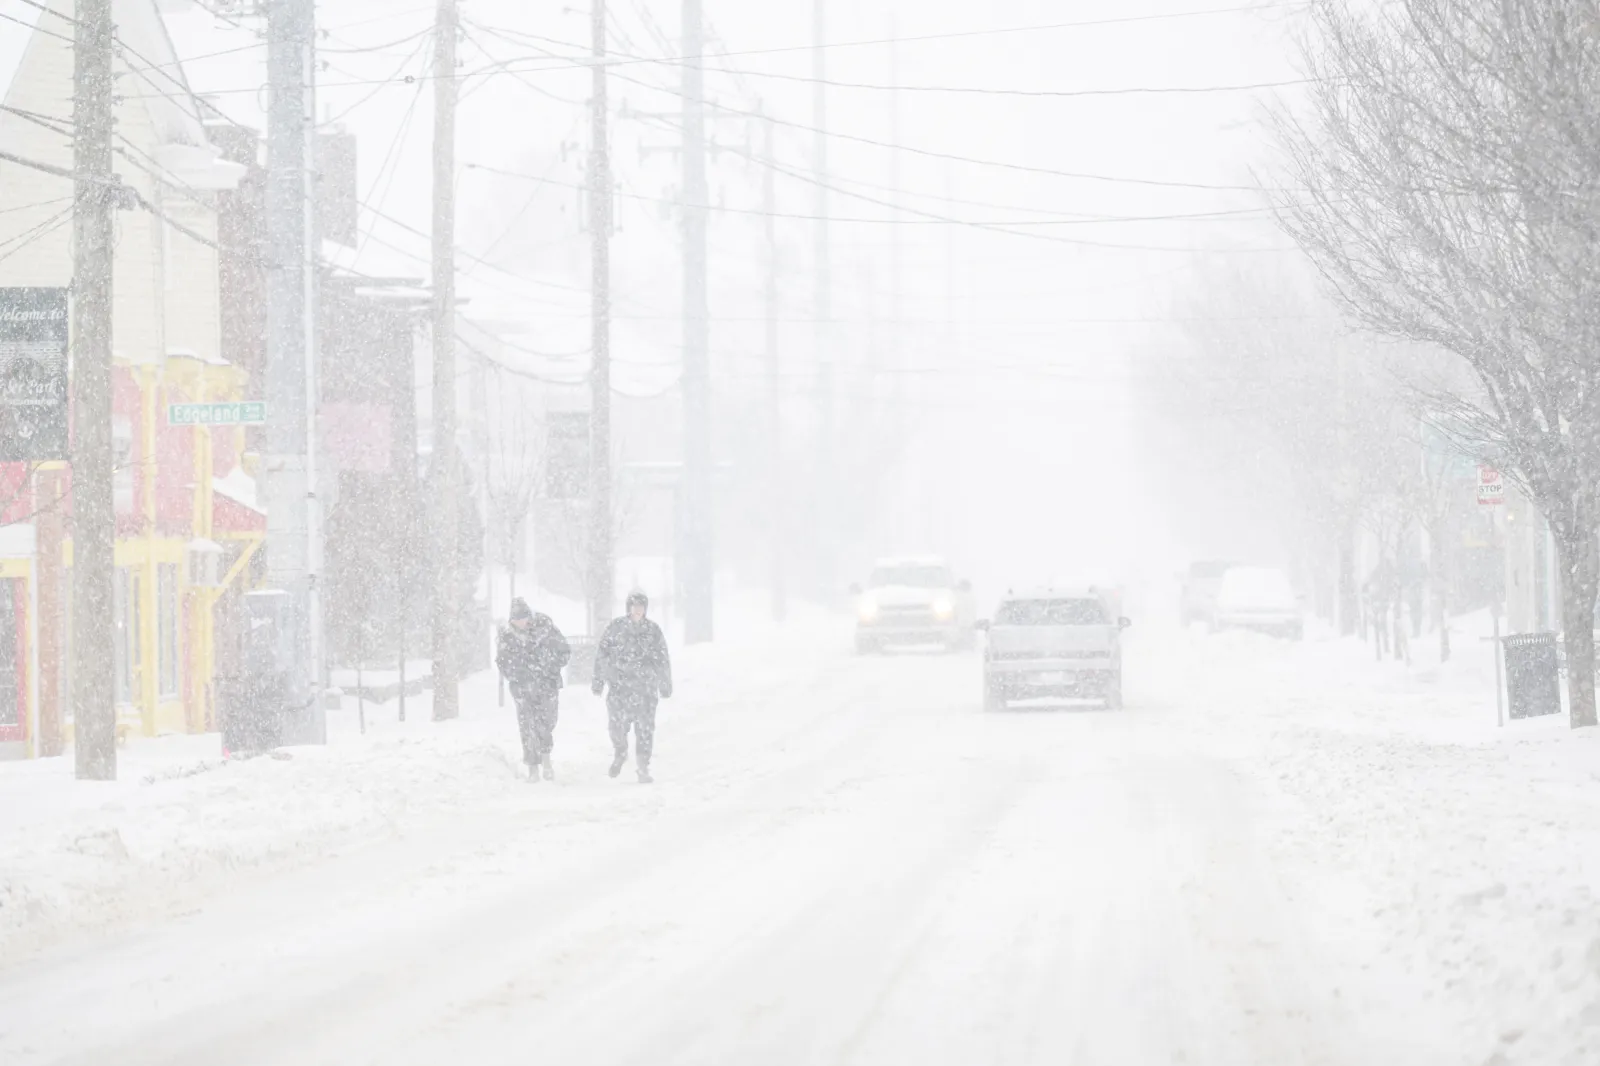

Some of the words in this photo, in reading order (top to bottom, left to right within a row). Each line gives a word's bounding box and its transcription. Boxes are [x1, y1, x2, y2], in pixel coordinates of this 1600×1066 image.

[51, 308, 64, 320] to
[174, 404, 240, 423] Edgeland
[1478, 484, 1502, 492] STOP
